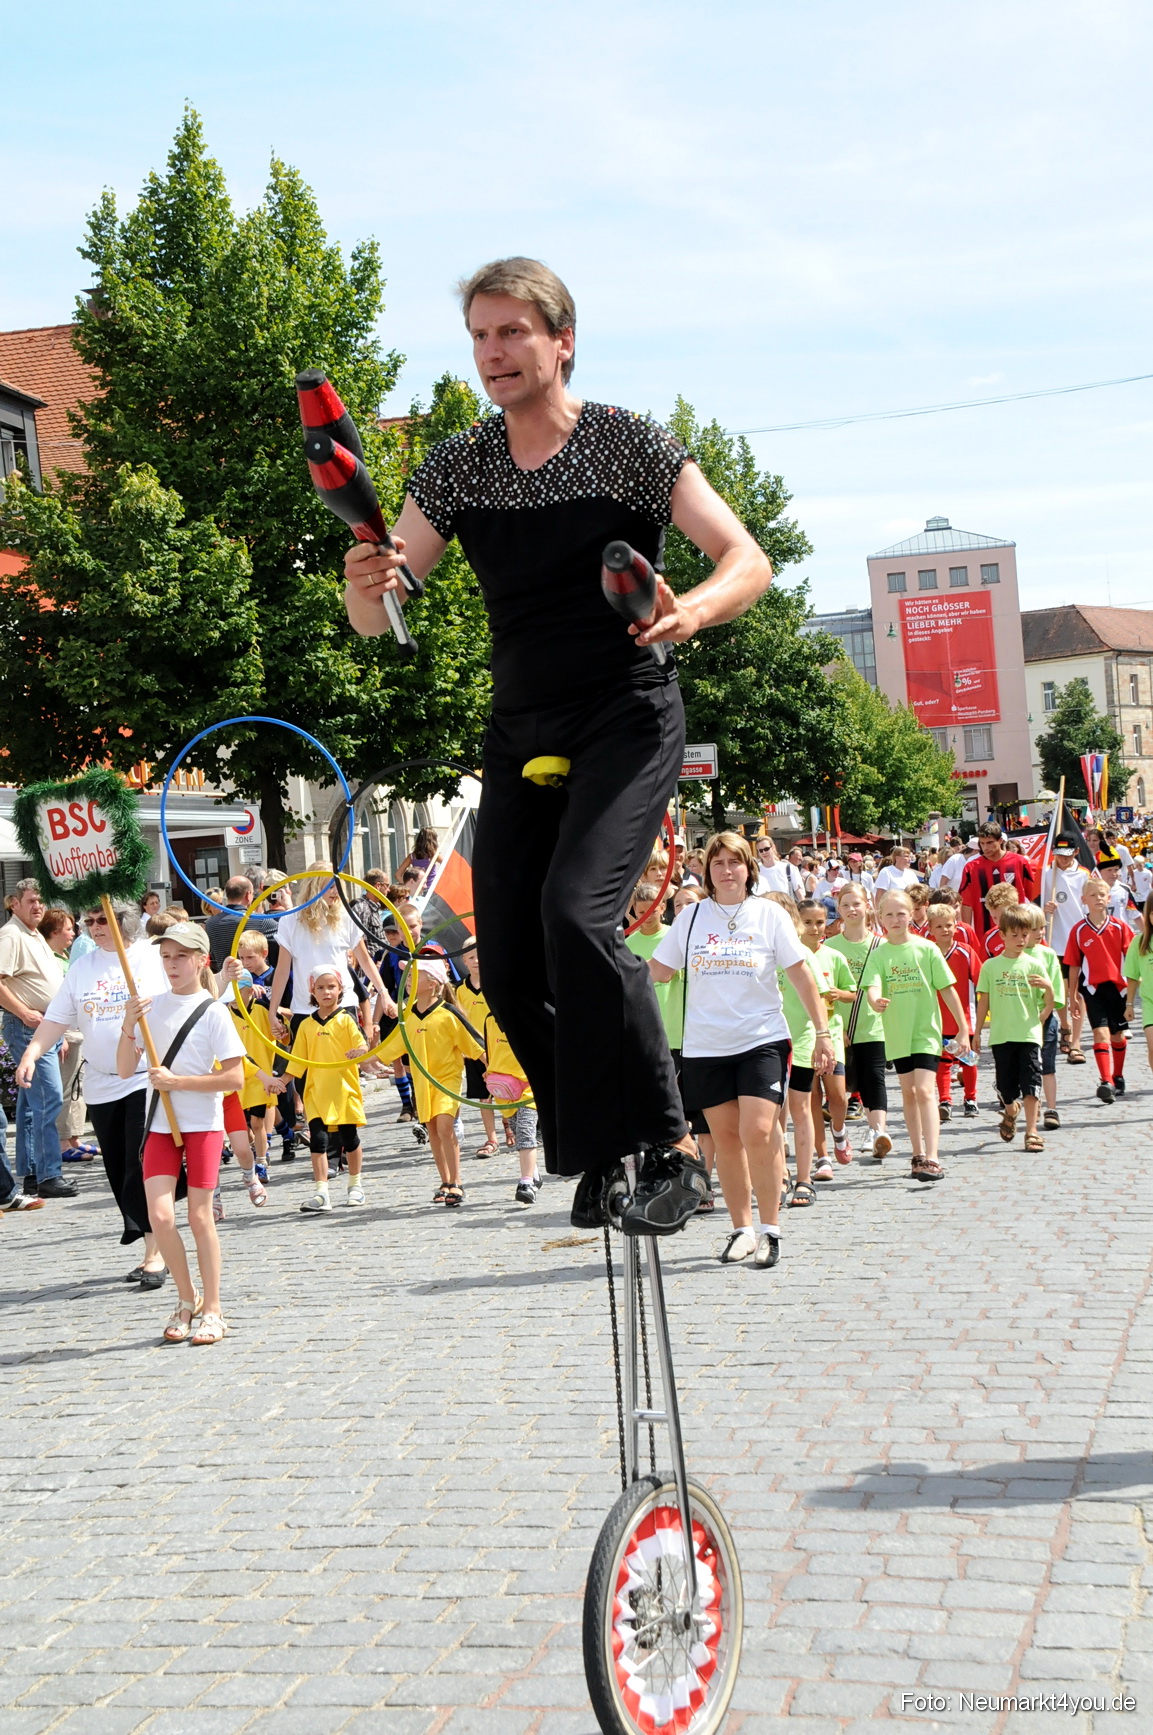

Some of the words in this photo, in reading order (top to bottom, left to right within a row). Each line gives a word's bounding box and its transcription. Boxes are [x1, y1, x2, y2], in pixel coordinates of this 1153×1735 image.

[905, 605, 930, 615] NOCH
[931, 601, 970, 612] GRÖSSER
[907, 620, 936, 630] LIEBER
[938, 618, 962, 627] MEHR
[47, 799, 107, 841] BSC
[234, 835, 254, 844] ZONE
[720, 946, 752, 957] Turn
[690, 955, 759, 970] Olympiade
